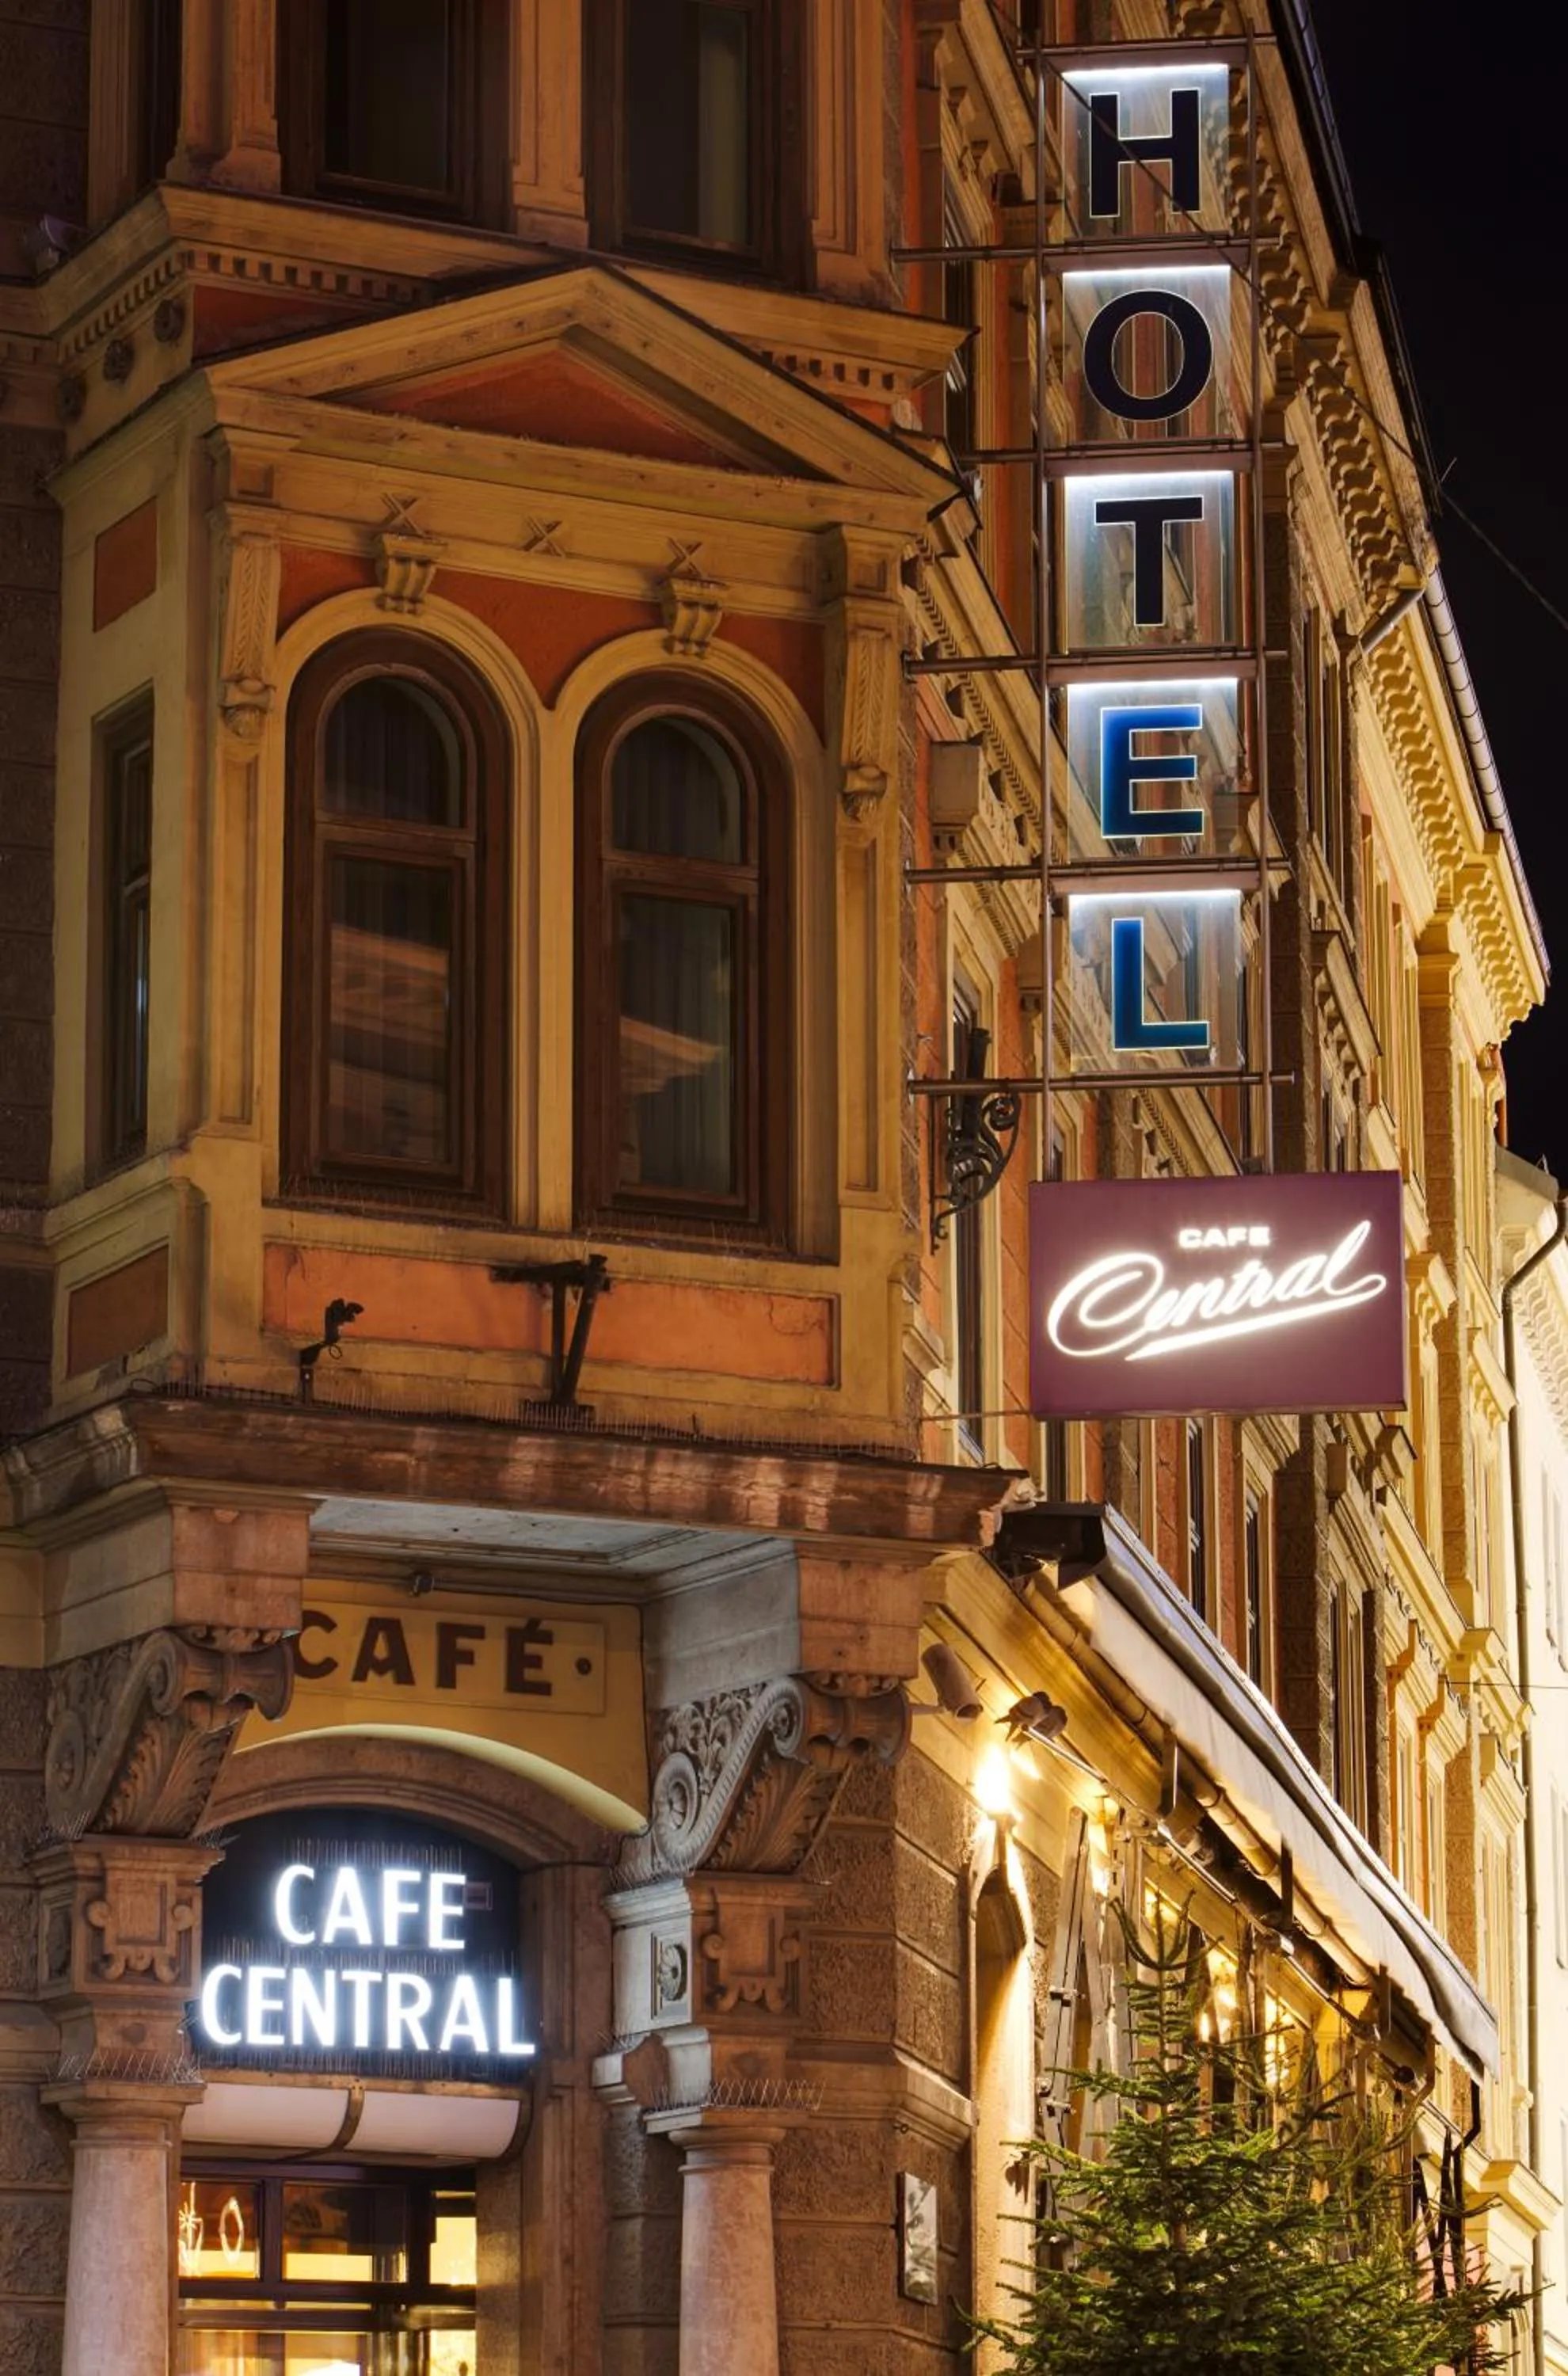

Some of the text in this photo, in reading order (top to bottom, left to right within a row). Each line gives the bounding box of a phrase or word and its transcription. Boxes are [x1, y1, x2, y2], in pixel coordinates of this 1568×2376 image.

[1083, 88, 1212, 1050] HOTEL
[1178, 1226, 1270, 1249] CAFE
[1048, 1220, 1387, 1361] Central
[293, 1610, 554, 1696] CAFÉ
[274, 1864, 466, 1950] CAFE
[200, 1964, 536, 2055] CENTRAL
